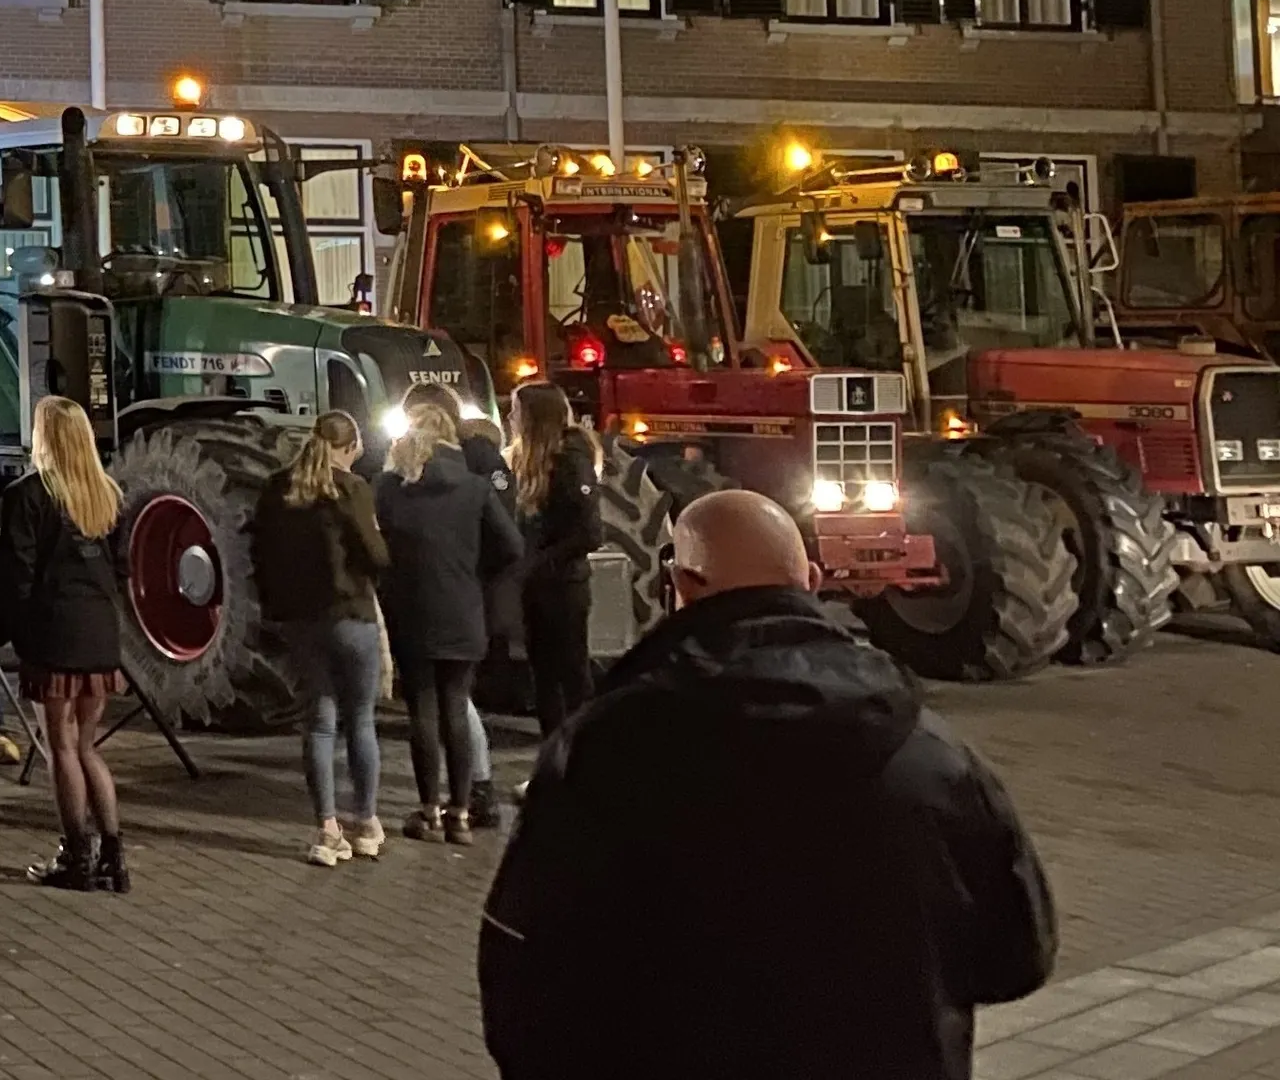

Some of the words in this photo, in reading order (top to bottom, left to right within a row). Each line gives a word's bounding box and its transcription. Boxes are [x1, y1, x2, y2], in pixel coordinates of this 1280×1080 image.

[582, 185, 667, 197] INTERNATIONAL
[153, 356, 196, 369] FENDT
[201, 358, 225, 370] 716
[408, 370, 461, 384] FENDT
[1128, 406, 1175, 419] 3080
